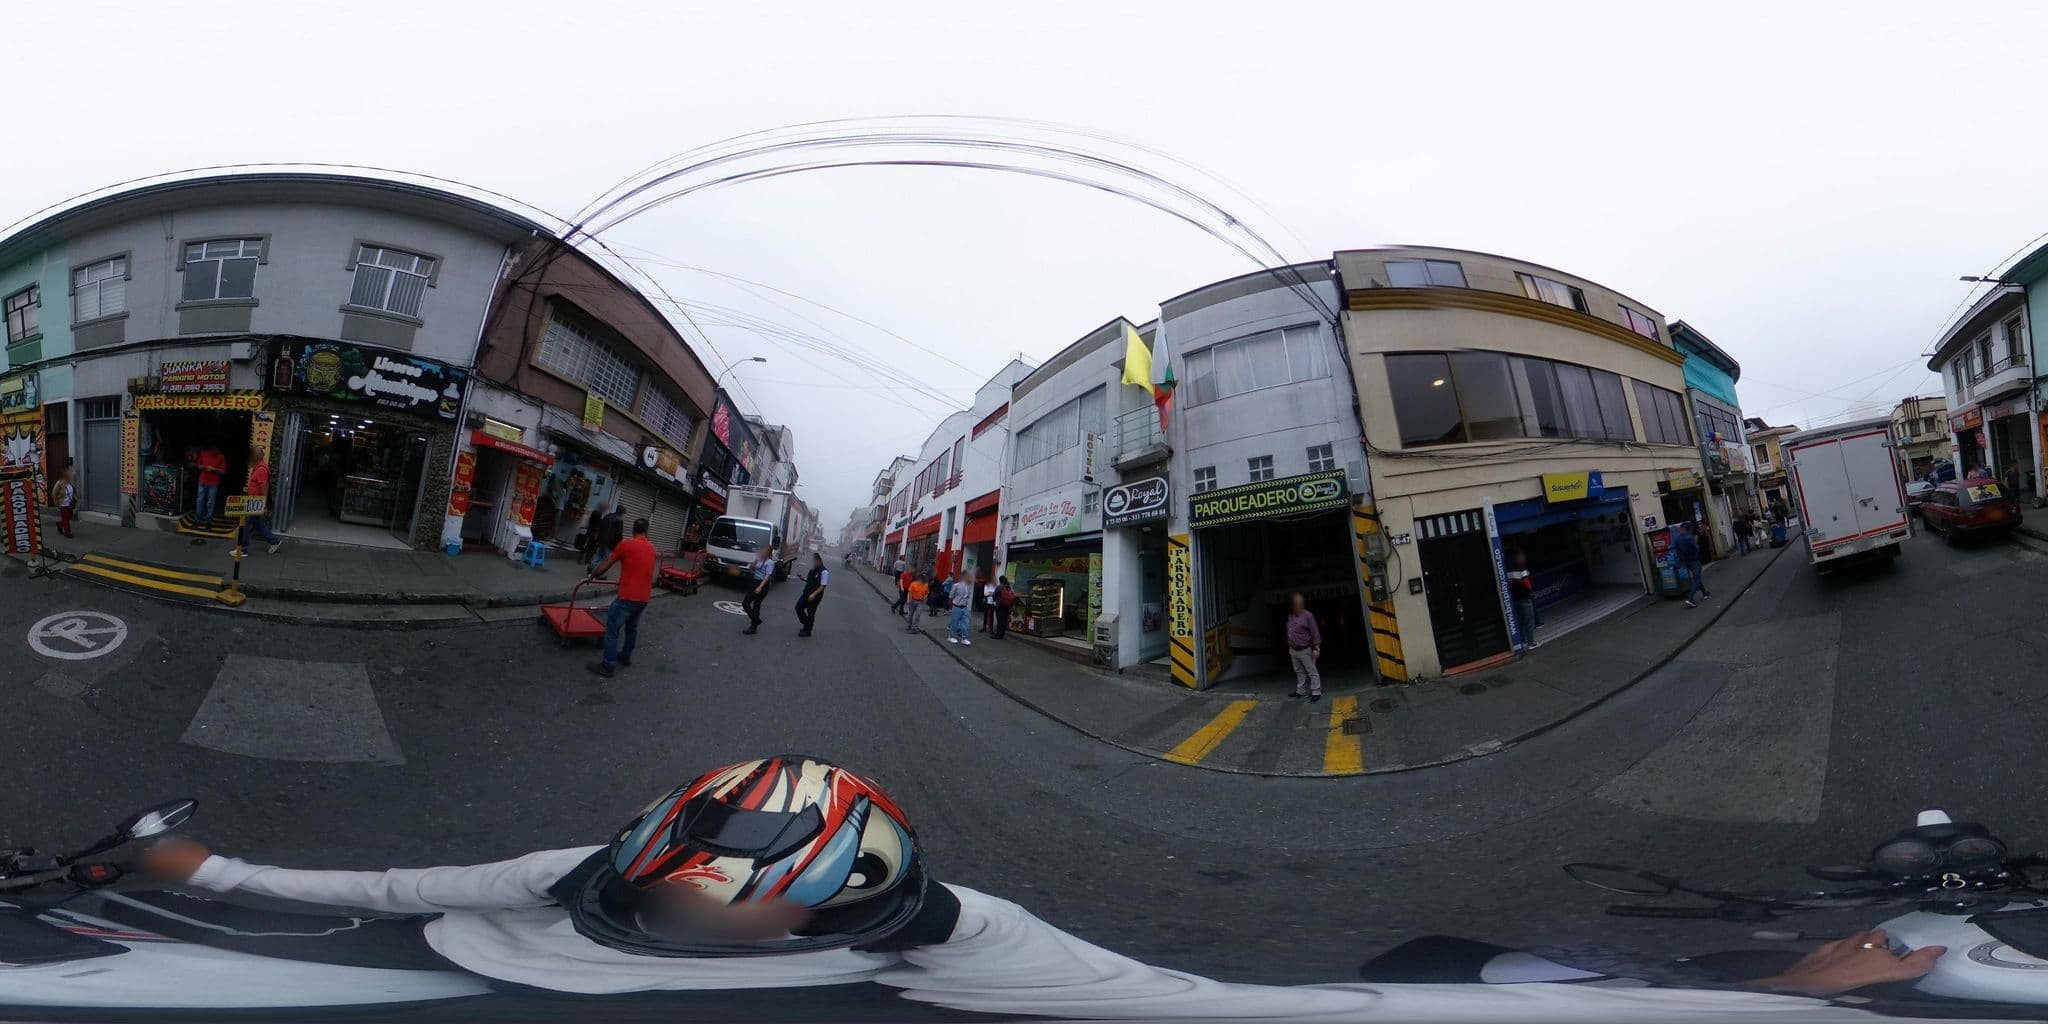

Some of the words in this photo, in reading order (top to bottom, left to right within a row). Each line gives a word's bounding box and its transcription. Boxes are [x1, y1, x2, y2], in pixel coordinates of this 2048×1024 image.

[164, 363, 202, 375] JUANKA
[373, 356, 423, 378] Licores
[136, 396, 260, 408] PARQUEADERO
[127, 420, 136, 486] PARQUEADERO
[1132, 481, 1162, 504] Royal
[1195, 488, 1297, 518] PARQUEADERO
[10, 480, 30, 553] PARQUEADERO
[1175, 550, 1186, 636] PARQUEADERO
[1494, 548, 1517, 636] www.betplay.com.co
